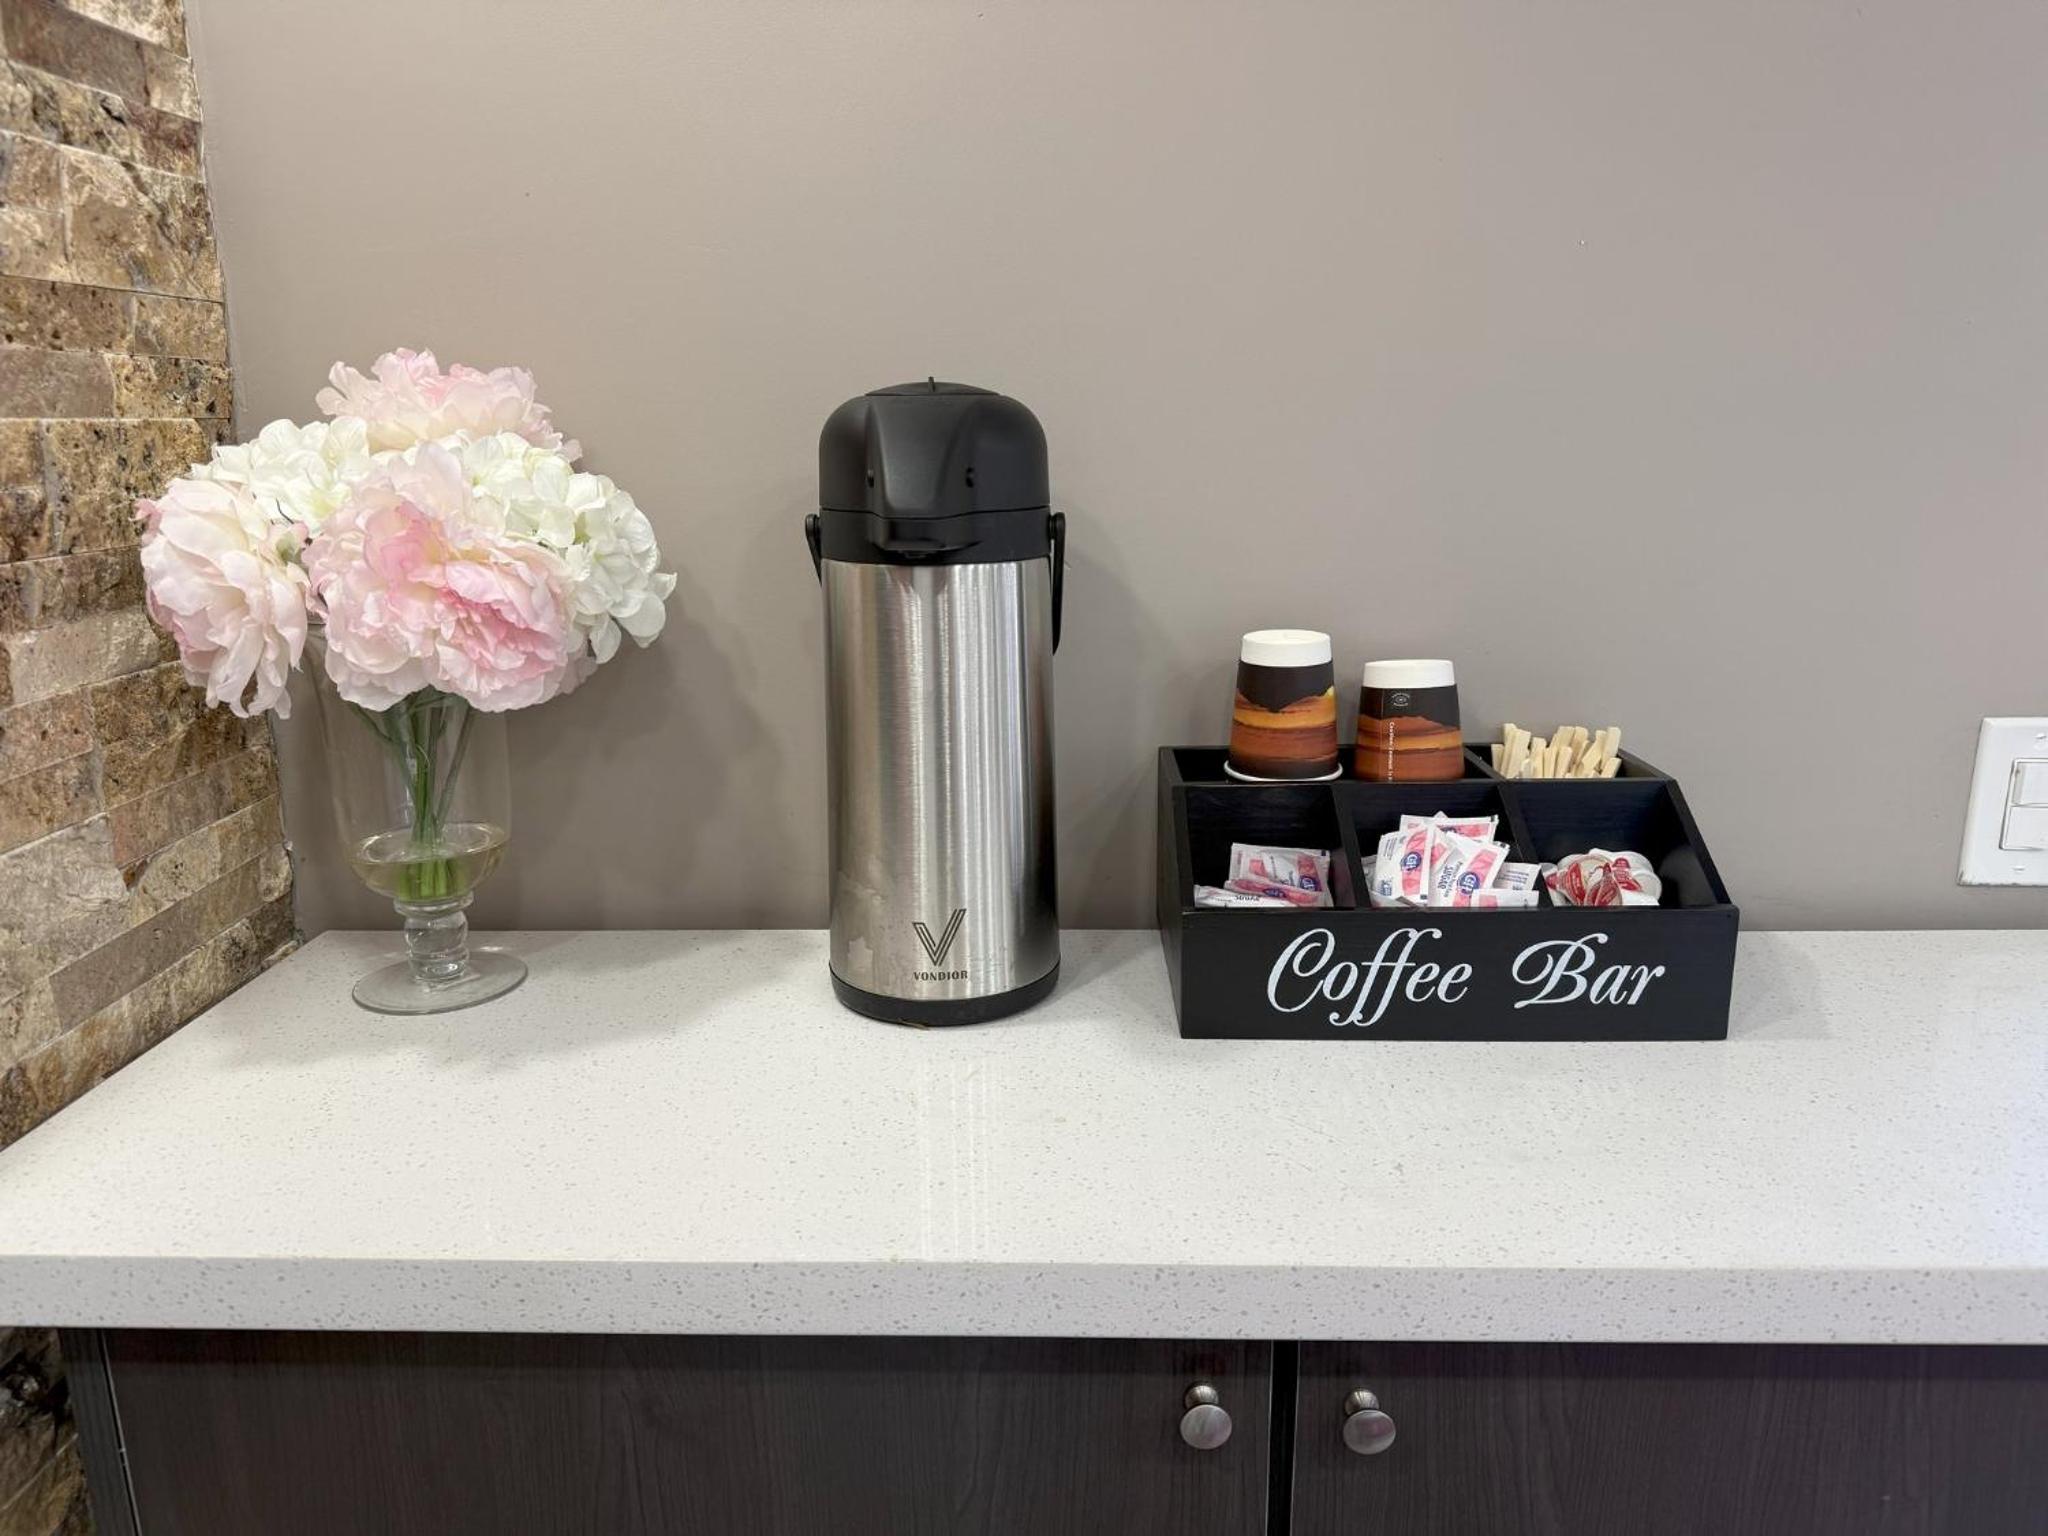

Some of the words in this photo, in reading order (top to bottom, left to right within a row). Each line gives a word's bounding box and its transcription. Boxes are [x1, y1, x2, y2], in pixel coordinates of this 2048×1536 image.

[913, 970, 968, 981] VONDIOR
[1267, 928, 1473, 1027] Coffee
[1511, 932, 1666, 1009] Bar
